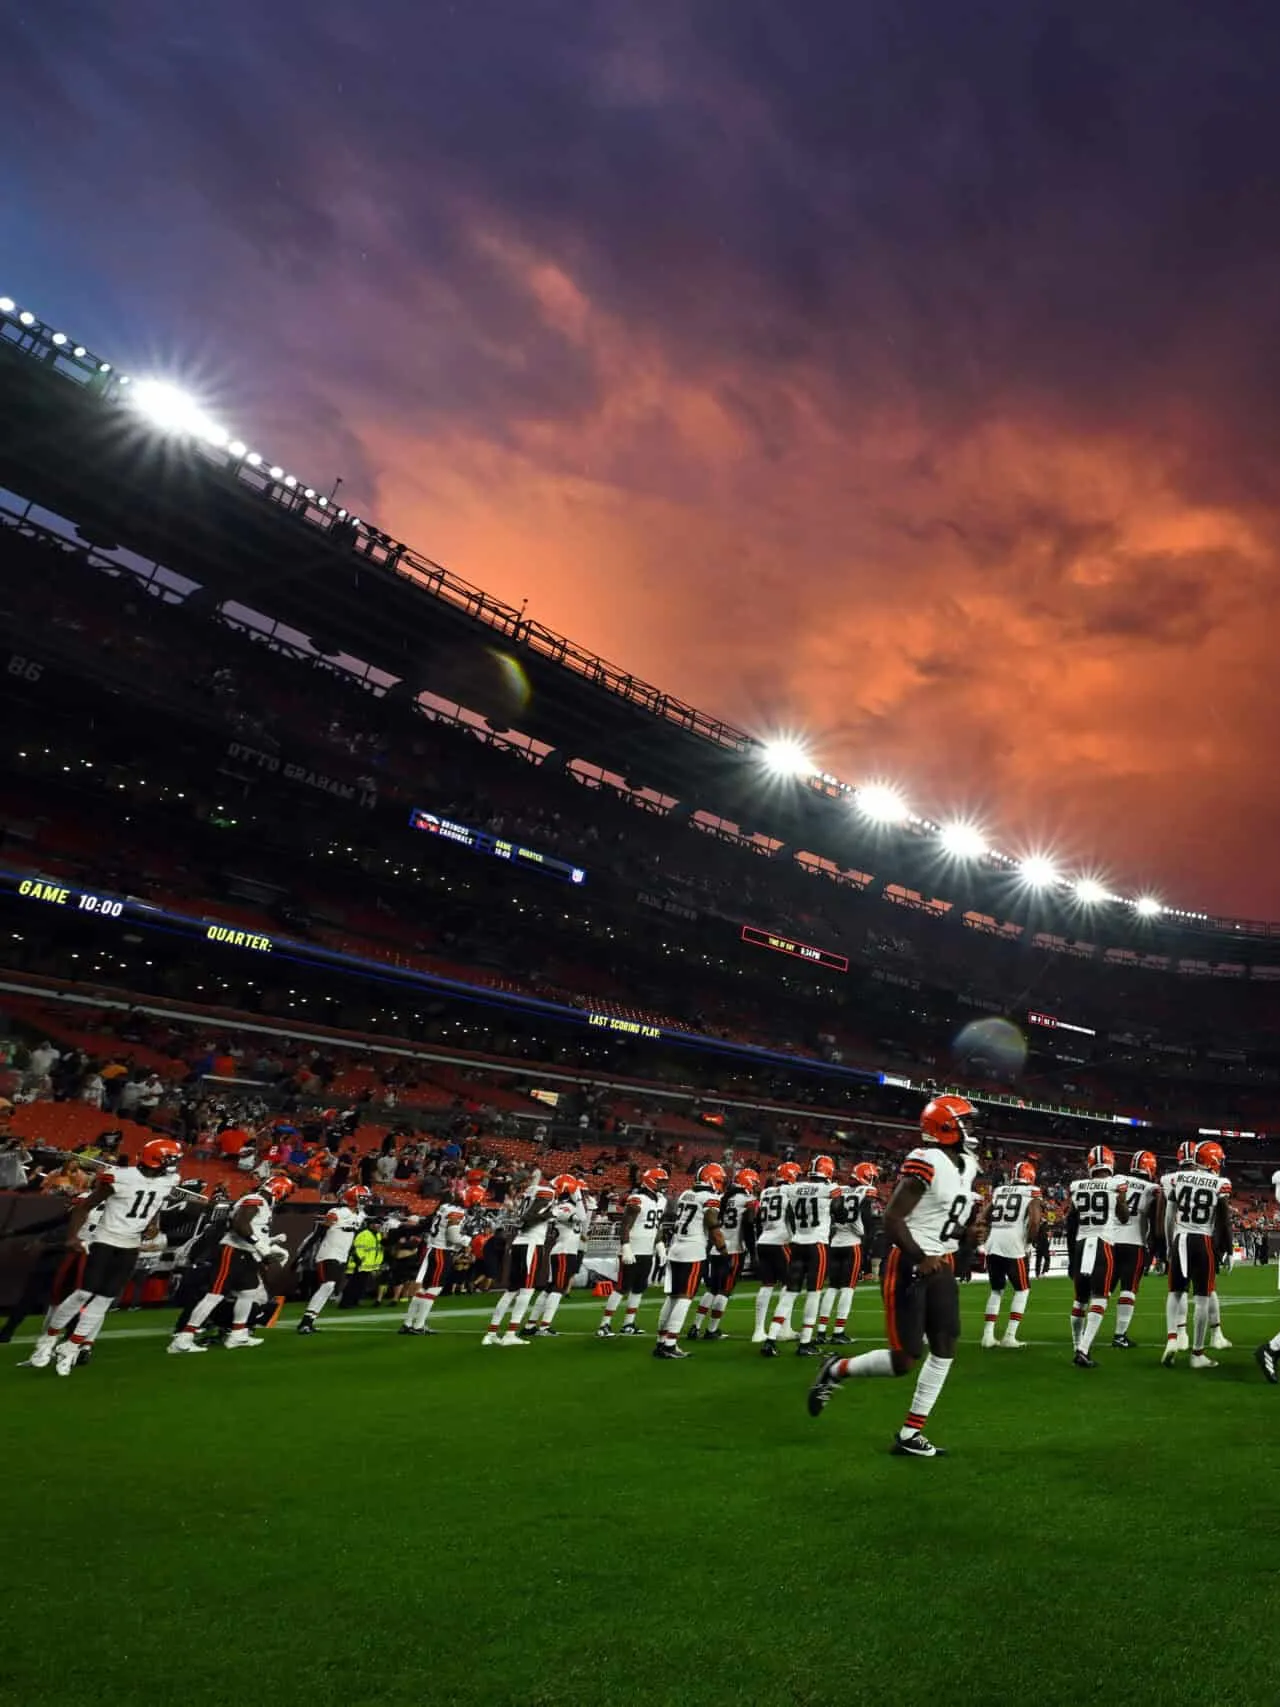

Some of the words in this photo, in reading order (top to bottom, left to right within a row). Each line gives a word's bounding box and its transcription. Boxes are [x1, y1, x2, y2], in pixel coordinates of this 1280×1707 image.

[227, 741, 281, 772] OTTO
[282, 761, 356, 799] GRAHAM
[18, 879, 71, 905] GAME
[78, 894, 123, 918] 10:00
[206, 925, 273, 952] QUARTER:
[588, 1014, 608, 1026] LAST
[609, 1019, 640, 1034] SCORING
[1079, 1181, 1108, 1191] MITCHELL
[125, 1189, 156, 1220] 11
[795, 1197, 820, 1229] 41
[940, 1194, 967, 1242] 8
[1077, 1191, 1109, 1226] 29
[1178, 1186, 1213, 1225] 48
